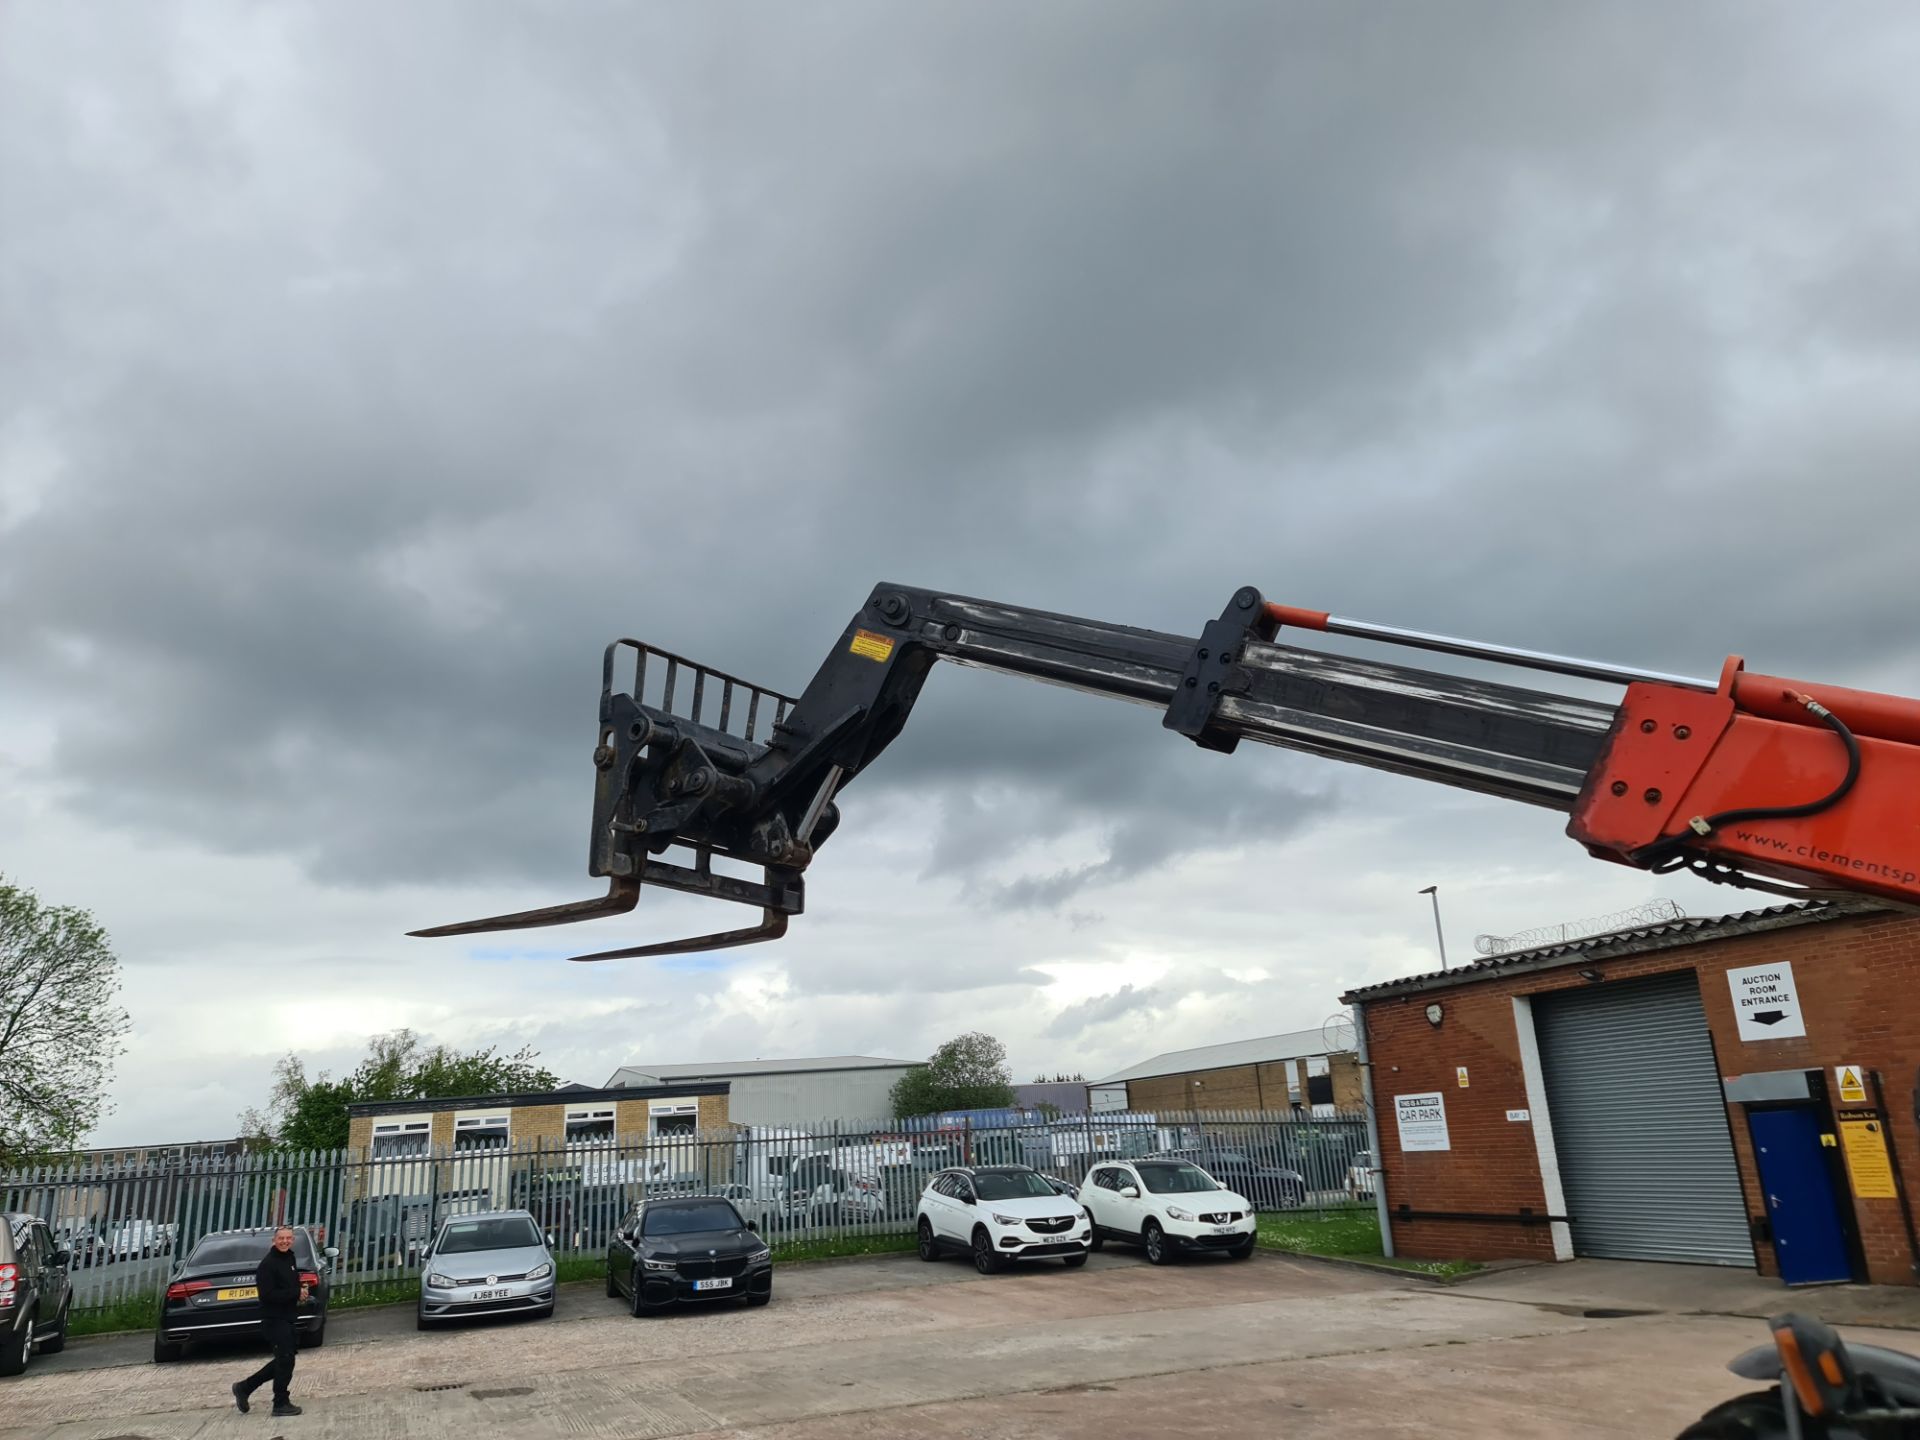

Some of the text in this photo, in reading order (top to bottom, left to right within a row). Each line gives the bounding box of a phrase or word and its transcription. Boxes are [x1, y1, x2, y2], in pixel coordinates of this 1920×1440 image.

[1737, 830, 1920, 884] www.clementsp
[1742, 973, 1782, 985] AUCTION
[1750, 985, 1777, 995] ROOM
[1741, 994, 1791, 1007] ENTRANCE
[1400, 1108, 1442, 1121] CAR PARK
[473, 1288, 509, 1300] AJ68 YEE
